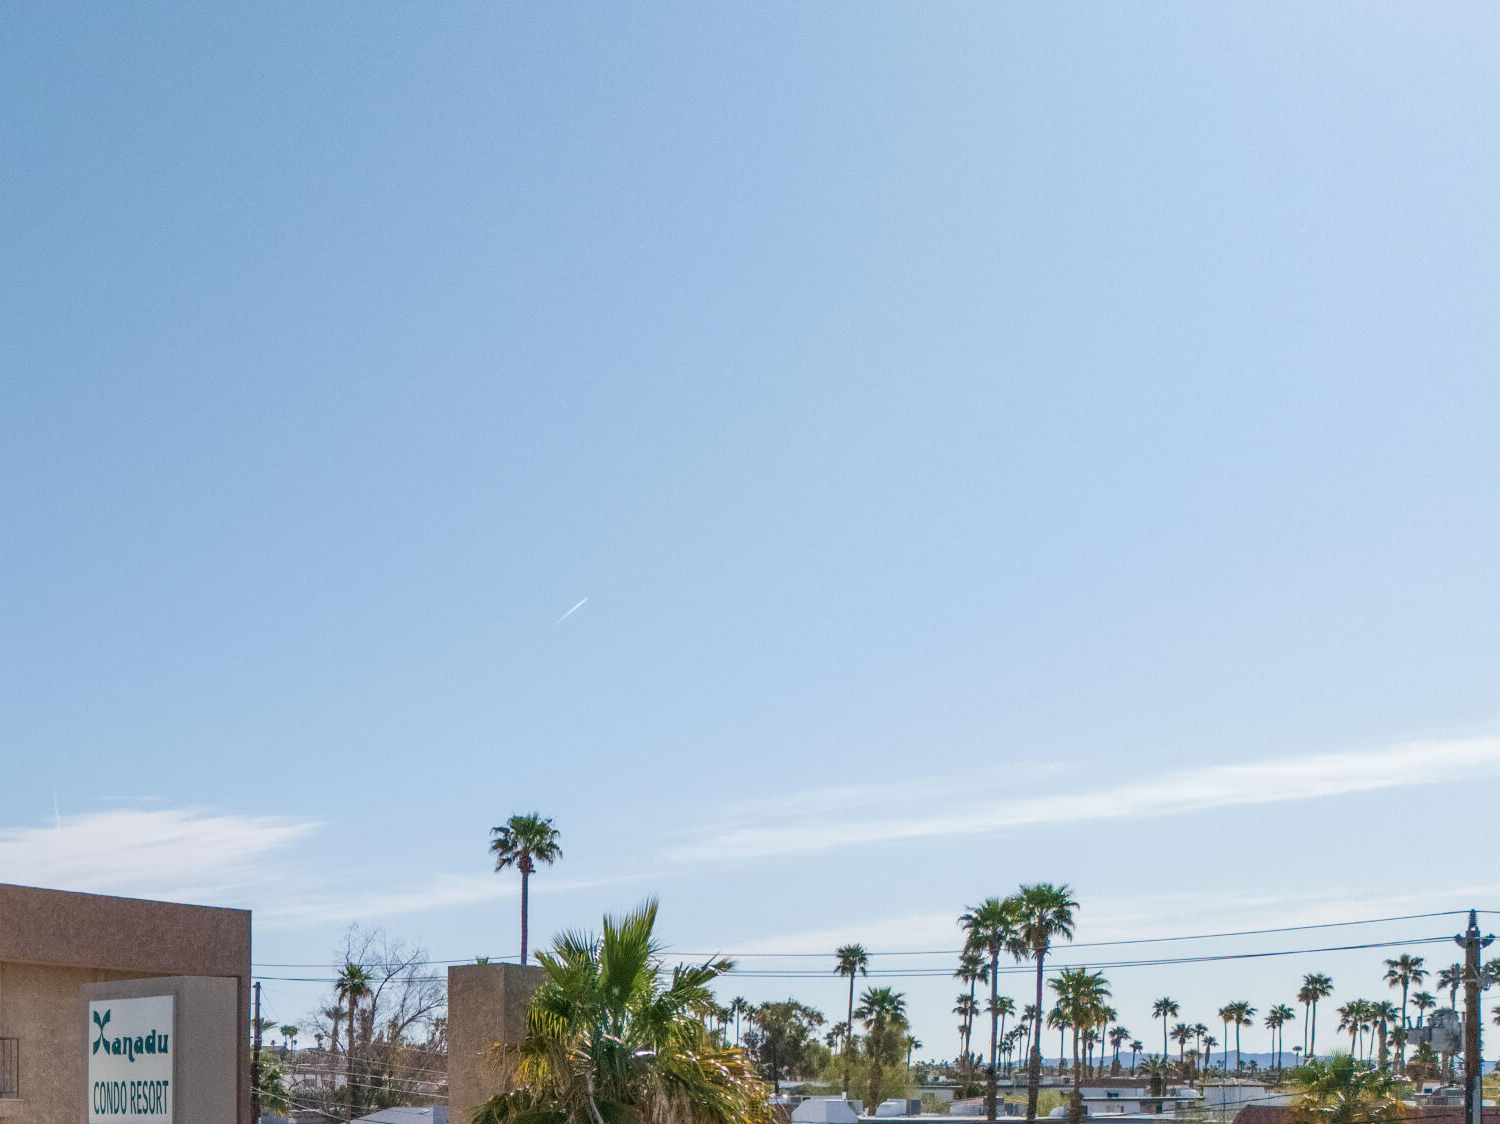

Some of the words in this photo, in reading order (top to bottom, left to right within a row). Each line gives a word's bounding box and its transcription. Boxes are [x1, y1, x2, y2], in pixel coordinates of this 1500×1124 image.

[92, 1008, 169, 1063] Xanadu
[93, 1081, 127, 1115] CONDO
[130, 1080, 169, 1115] RESORT
